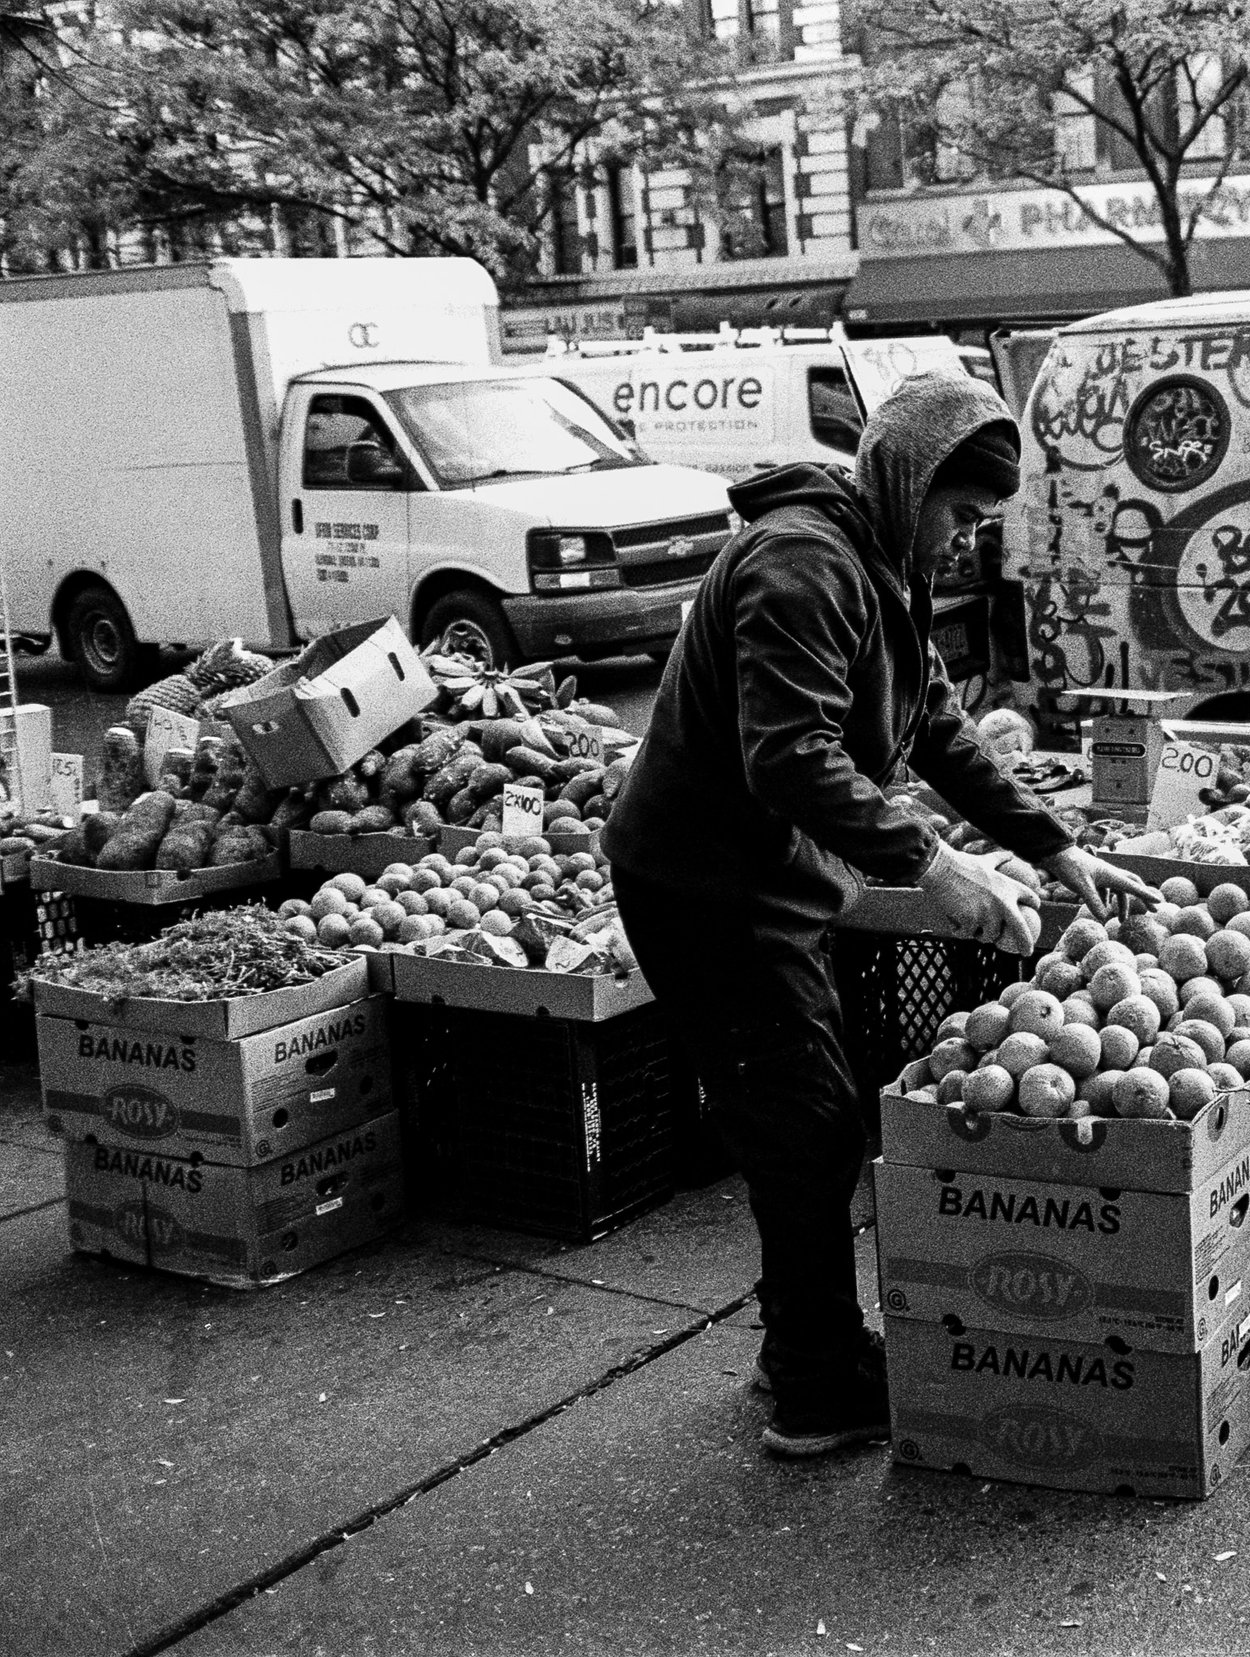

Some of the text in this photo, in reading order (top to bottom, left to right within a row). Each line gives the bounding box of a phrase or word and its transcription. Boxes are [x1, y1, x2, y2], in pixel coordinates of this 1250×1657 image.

[613, 376, 763, 414] encore
[654, 419, 758, 432] PROTECTION
[564, 731, 599, 757] 200
[79, 1034, 196, 1072] BANANAS
[274, 1014, 366, 1064] BANANAS
[110, 1095, 169, 1128] ROSY
[94, 1152, 202, 1194] BANANAS
[280, 1131, 377, 1185] BANANAS
[939, 1186, 1121, 1234] BANANAS
[987, 1264, 1076, 1306] ROSY
[951, 1343, 1135, 1391] BANANAS
